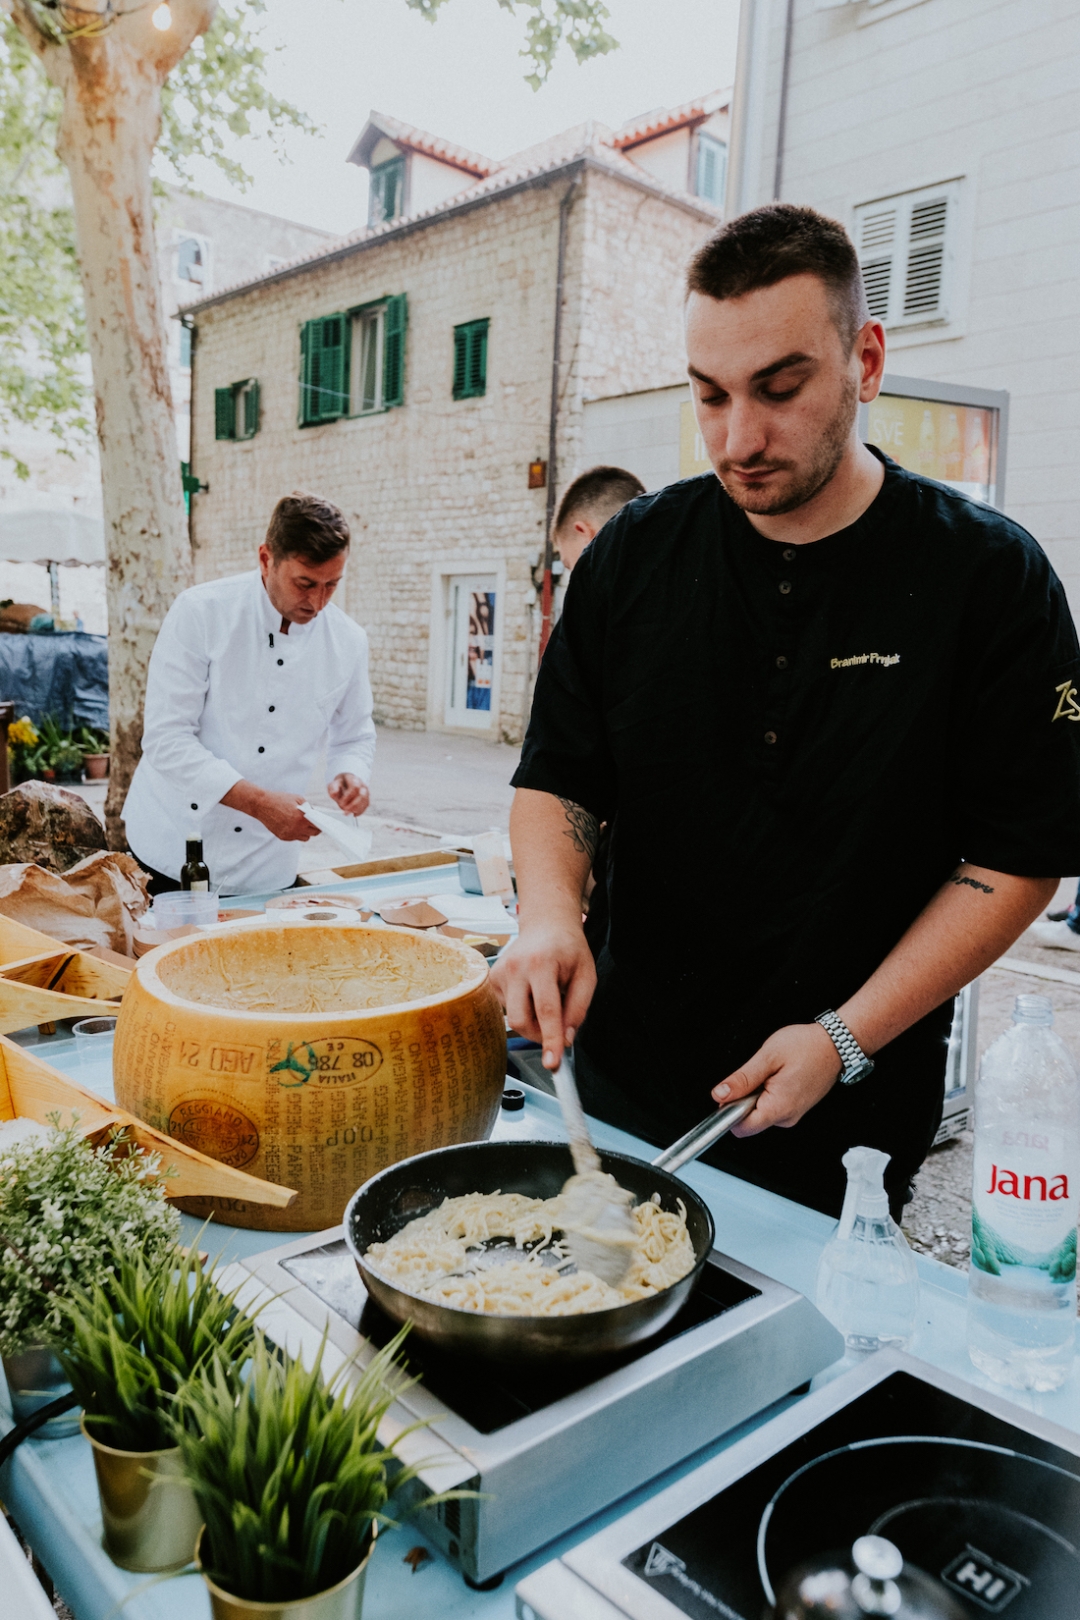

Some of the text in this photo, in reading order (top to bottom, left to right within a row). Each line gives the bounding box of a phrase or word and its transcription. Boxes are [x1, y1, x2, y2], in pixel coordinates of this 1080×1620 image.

[872, 418, 904, 446] SVE
[318, 1072, 356, 1084] ITALIA
[180, 1105, 242, 1127] REGGIANO
[986, 1164, 1069, 1201] Jana
[957, 1562, 1005, 1600] HI
